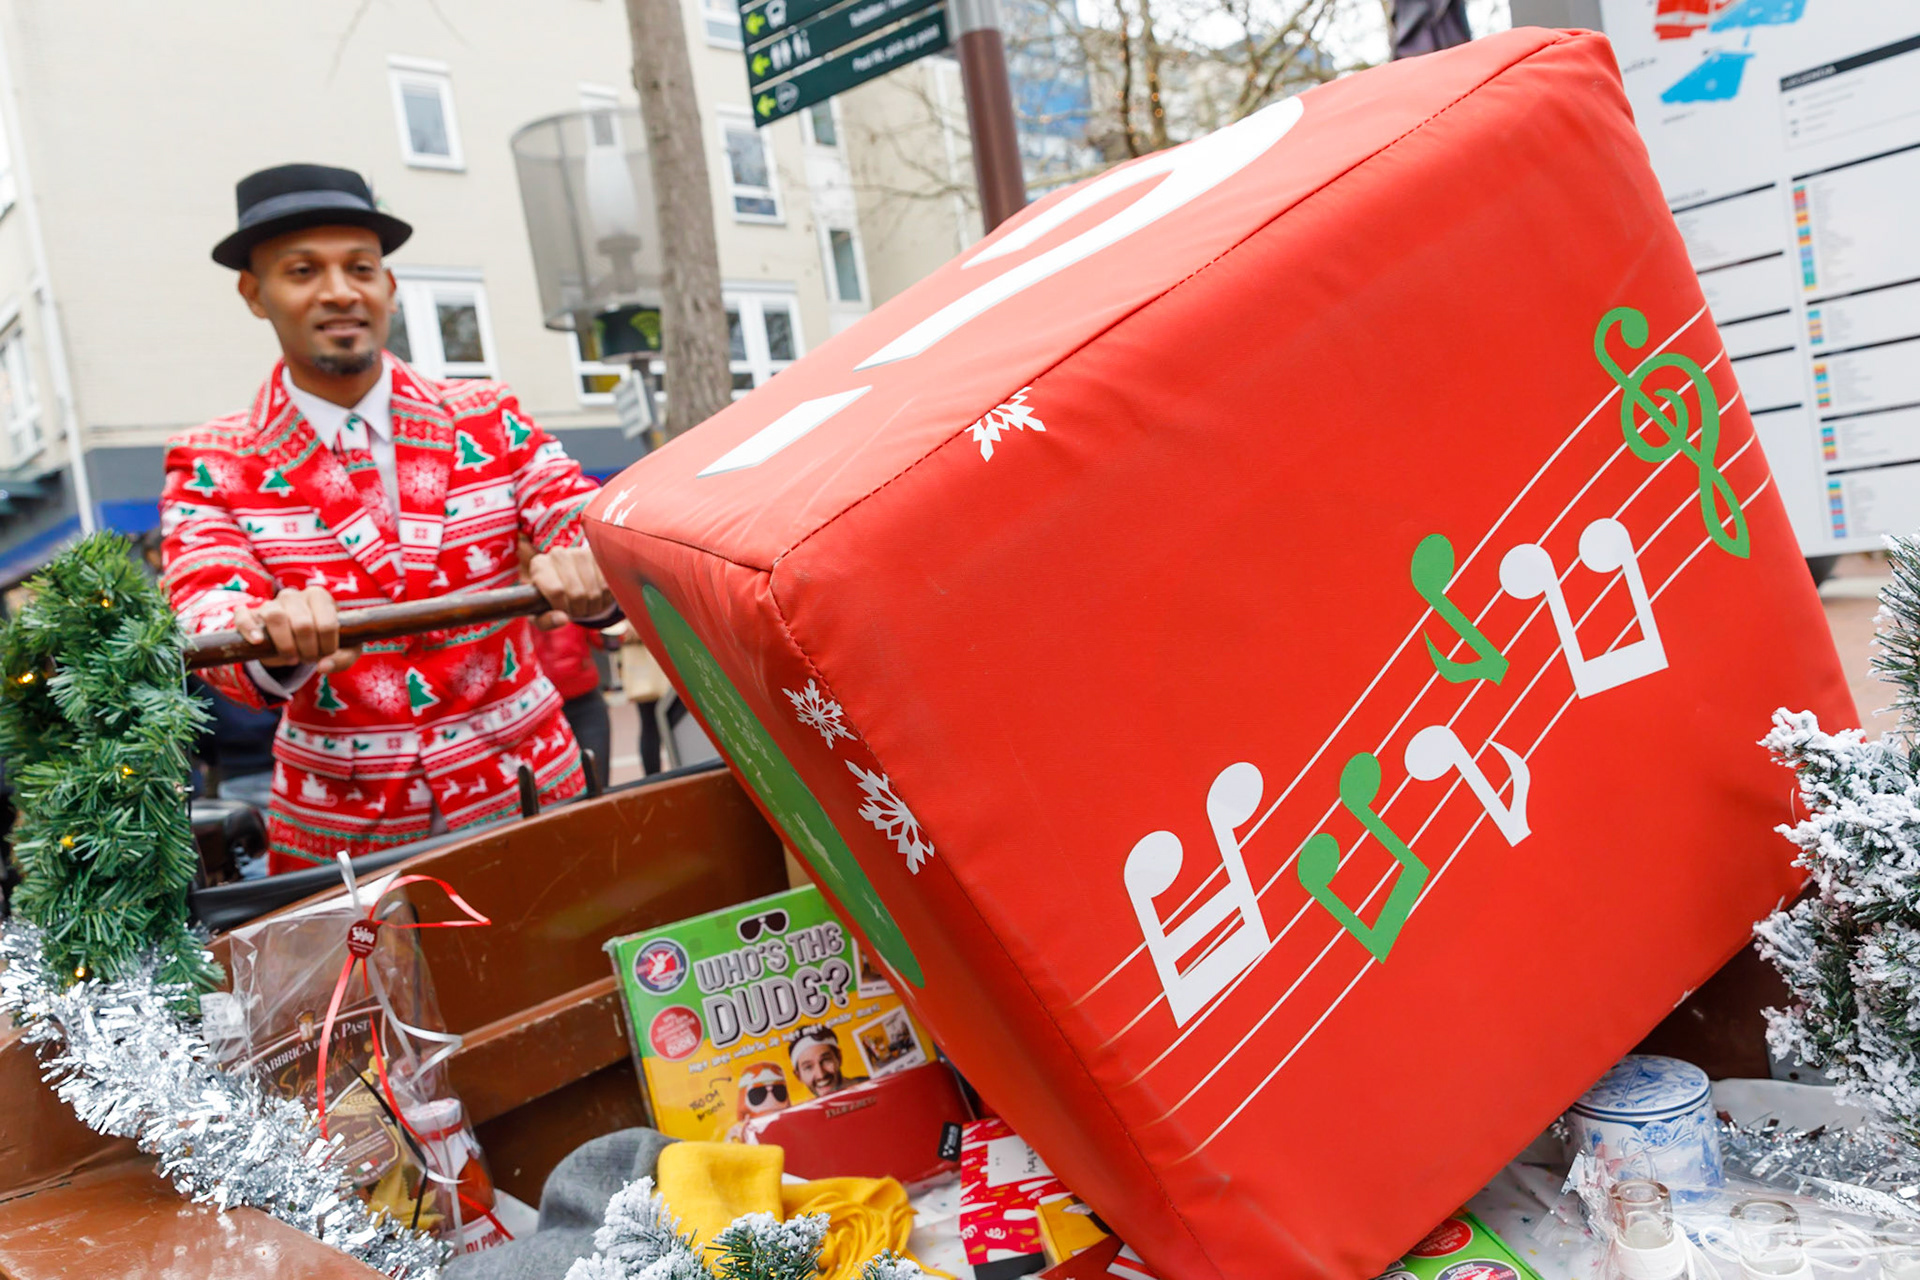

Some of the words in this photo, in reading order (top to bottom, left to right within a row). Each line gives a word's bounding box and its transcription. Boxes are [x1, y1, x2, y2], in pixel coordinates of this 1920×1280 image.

[693, 938, 790, 994] WHO'S
[785, 921, 846, 965] THE
[341, 1019, 371, 1039] PAST
[702, 957, 853, 1050] DUDE?
